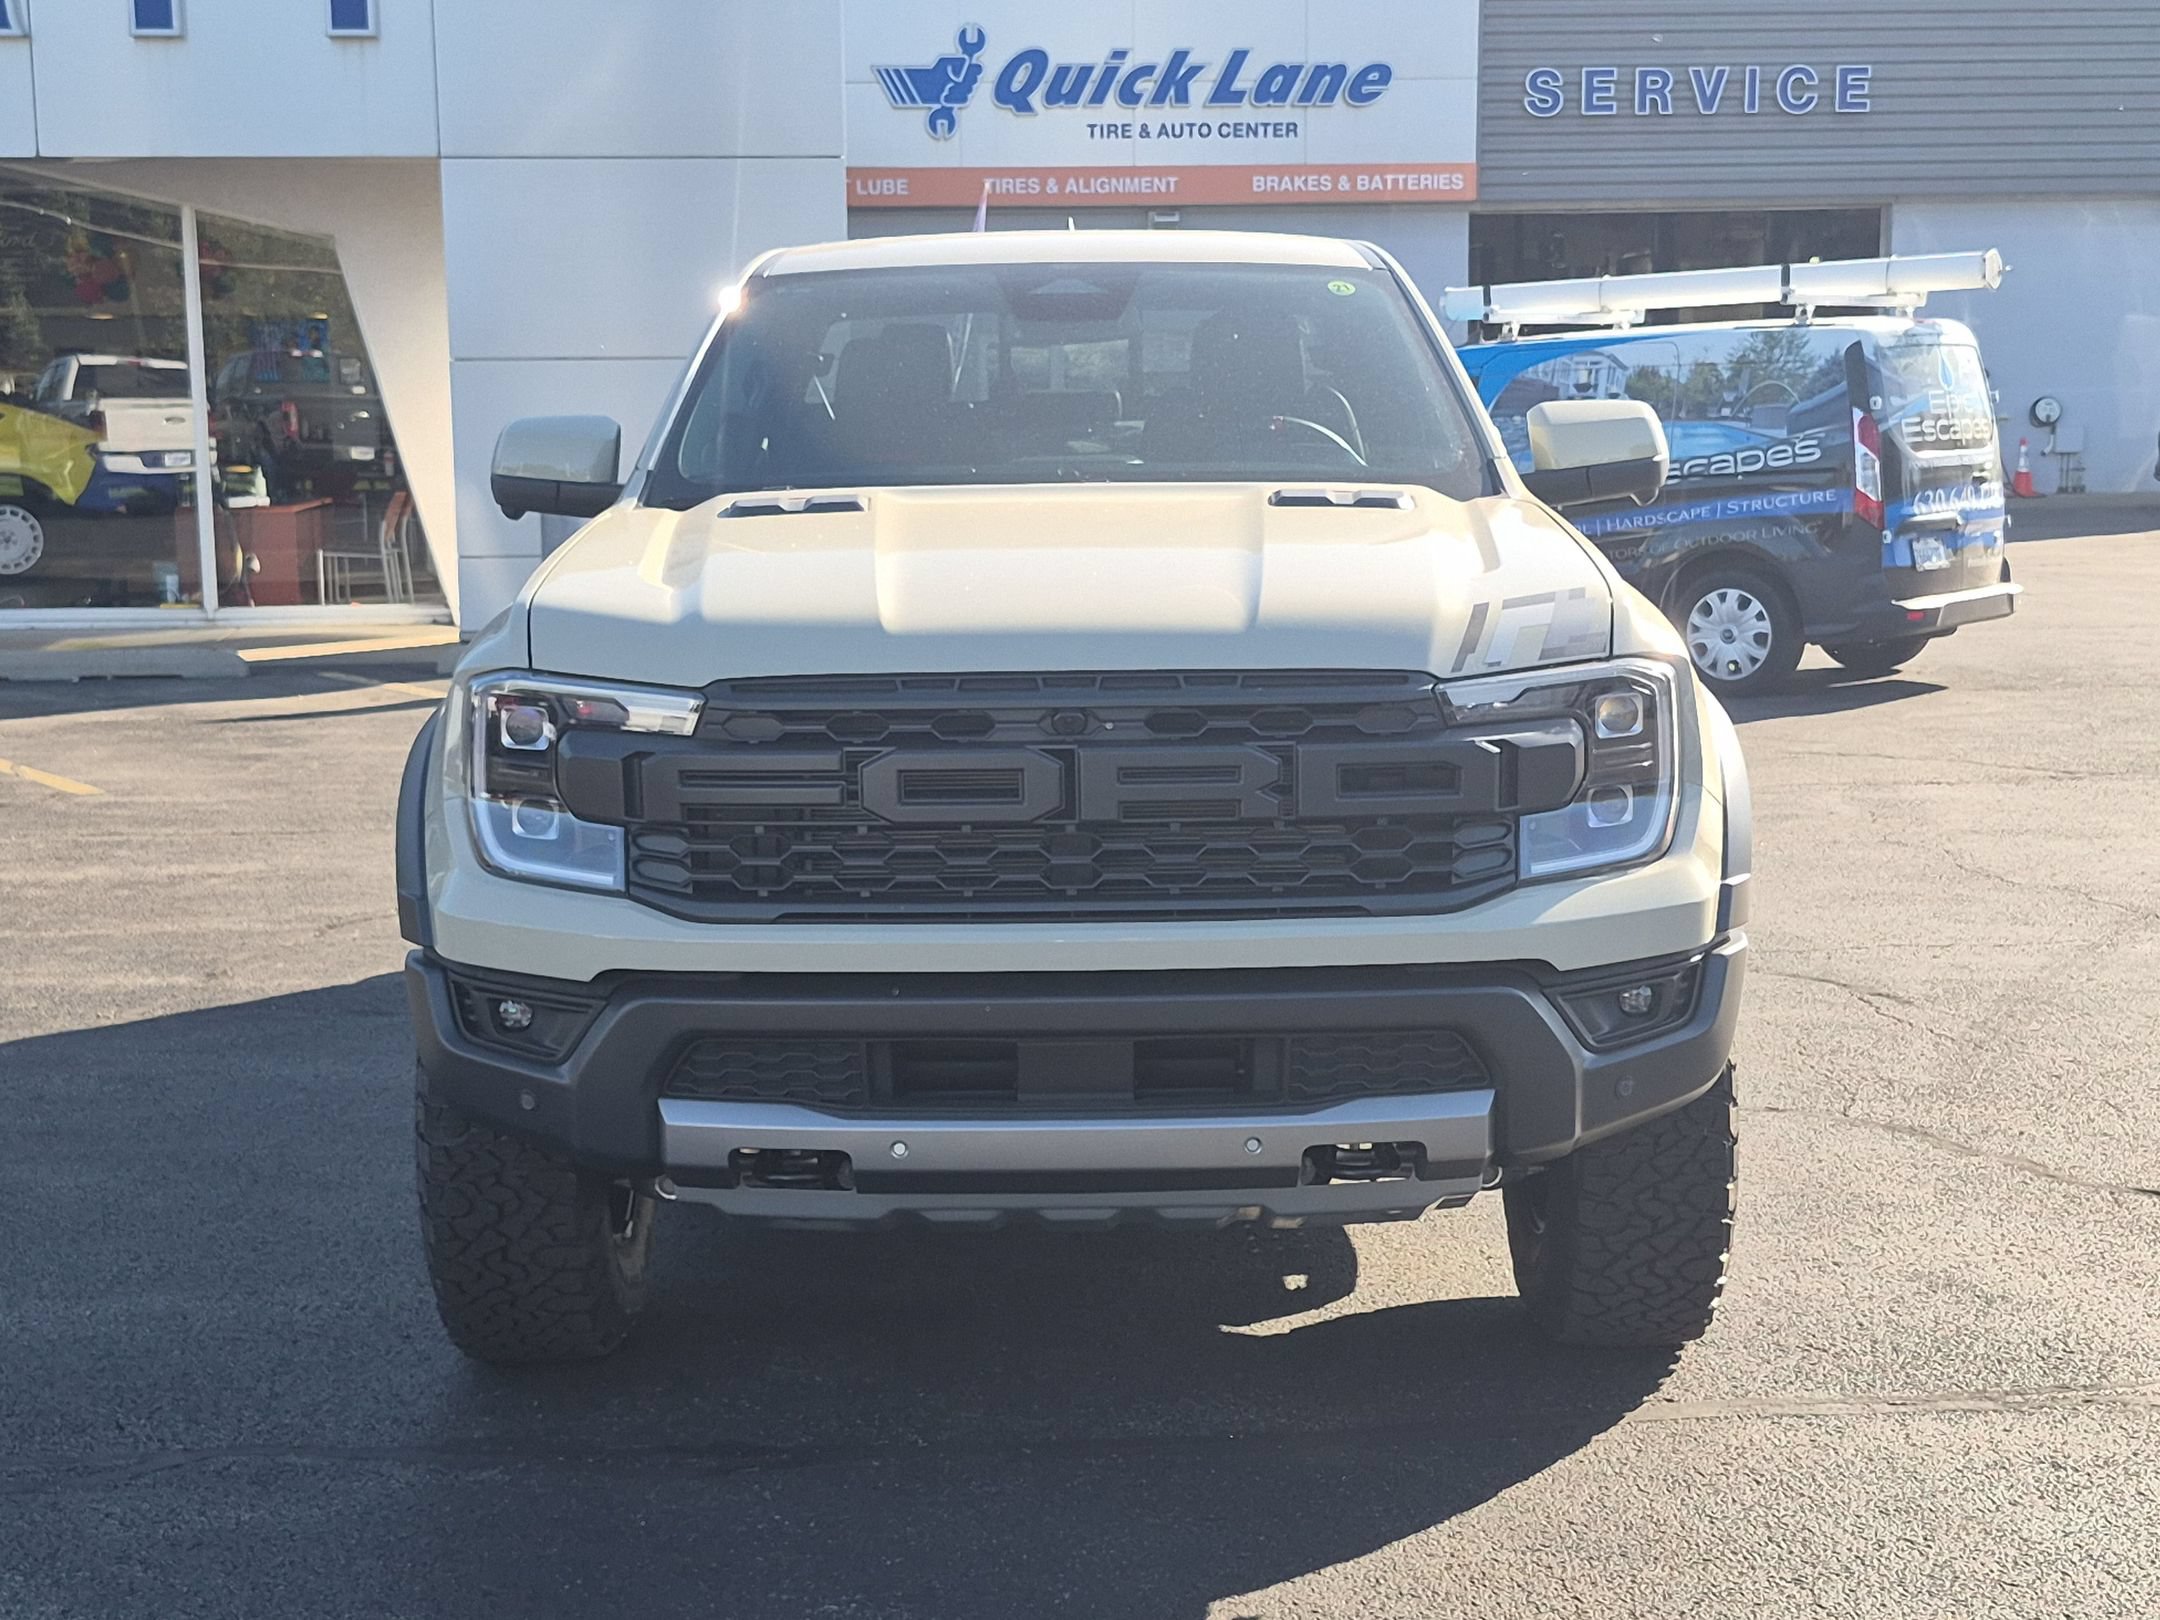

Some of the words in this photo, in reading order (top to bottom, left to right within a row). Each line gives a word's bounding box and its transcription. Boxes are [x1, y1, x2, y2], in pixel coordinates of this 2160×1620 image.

[993, 46, 1203, 115] Quick
[1202, 47, 1394, 109] Lane
[1523, 64, 1872, 117] SERVICE
[1087, 123, 1133, 139] TIRE
[1138, 123, 1151, 139] &
[1156, 122, 1212, 139] AUTO
[1217, 122, 1298, 138] CENTER
[856, 179, 909, 195] LUBE
[984, 178, 1040, 194] TIRES
[1046, 177, 1059, 194] &
[1064, 176, 1179, 193] ALIGNMENT
[1252, 175, 1332, 192] BRAKES
[1337, 175, 1350, 191] &
[1356, 174, 1464, 190] BATTERIES
[1902, 416, 1992, 446] Escapes
[1664, 436, 1824, 485] scapes
[1606, 505, 1711, 533] HARDSCAPE
[1726, 489, 1838, 515] STRUCTURE
[641, 742, 1500, 824] FORD
